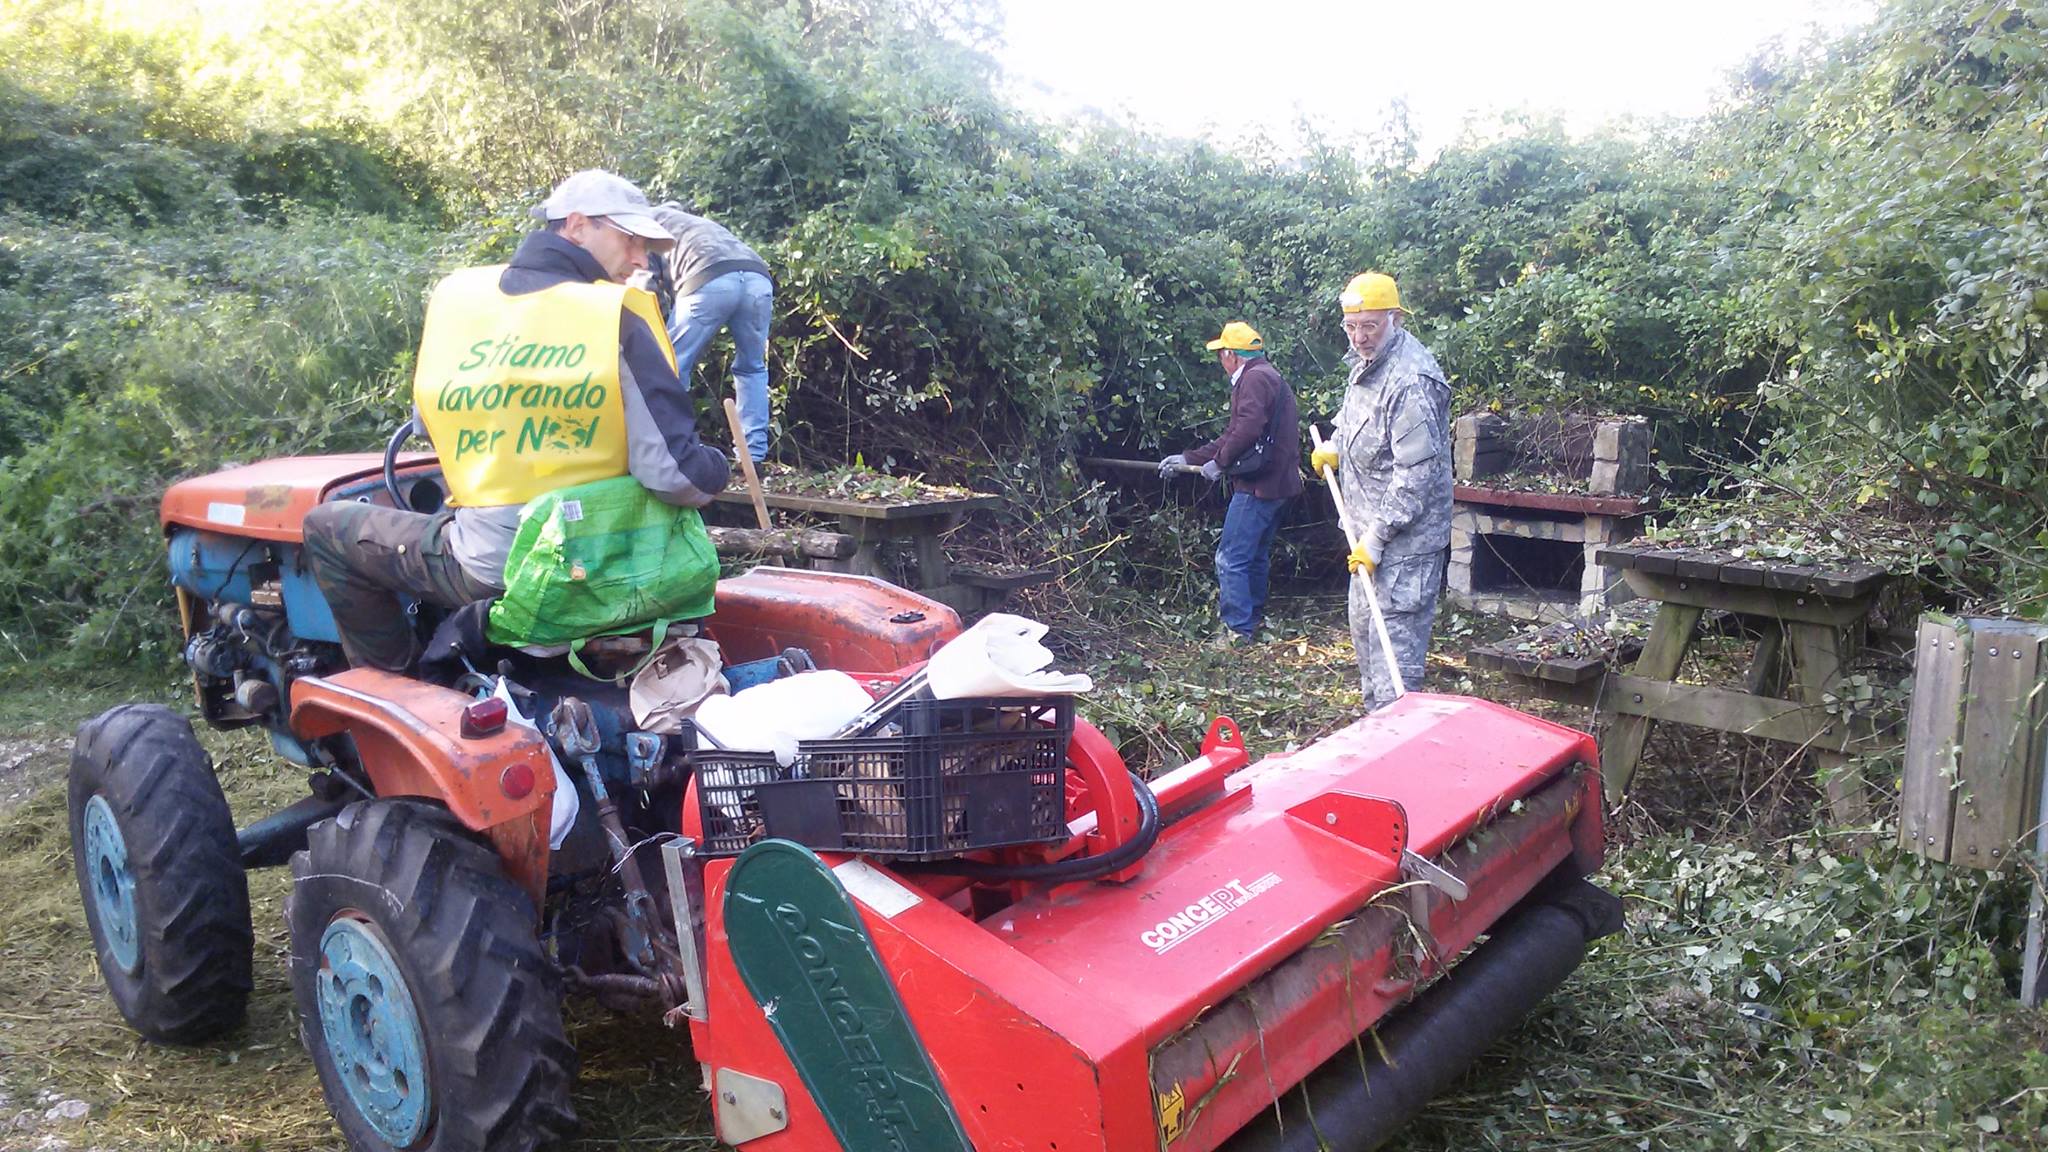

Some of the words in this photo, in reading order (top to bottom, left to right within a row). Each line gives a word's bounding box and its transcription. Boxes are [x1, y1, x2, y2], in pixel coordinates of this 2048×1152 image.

[458, 333, 586, 371] Stiamo
[437, 371, 607, 411] lavorando
[456, 429, 506, 461] per
[1141, 879, 1247, 949] CONCEPT
[776, 902, 920, 1132] CONCEPT
